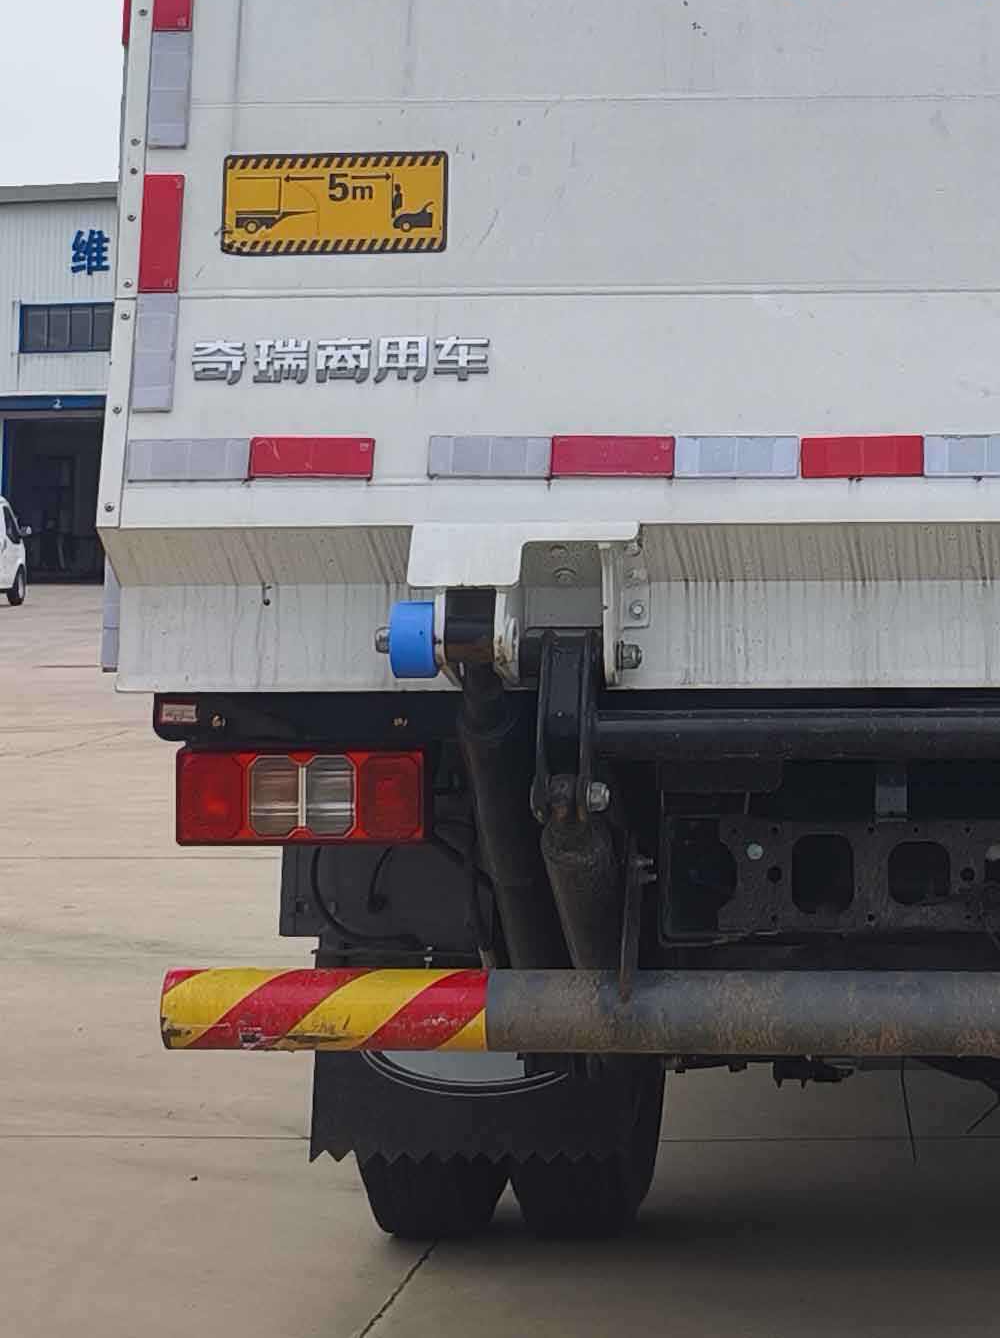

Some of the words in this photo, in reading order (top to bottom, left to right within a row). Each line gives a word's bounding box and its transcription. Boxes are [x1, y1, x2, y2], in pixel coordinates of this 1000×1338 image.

[328, 172, 375, 202] 5m
[71, 229, 111, 275] 维
[191, 334, 491, 385] 奇瑞商用车
